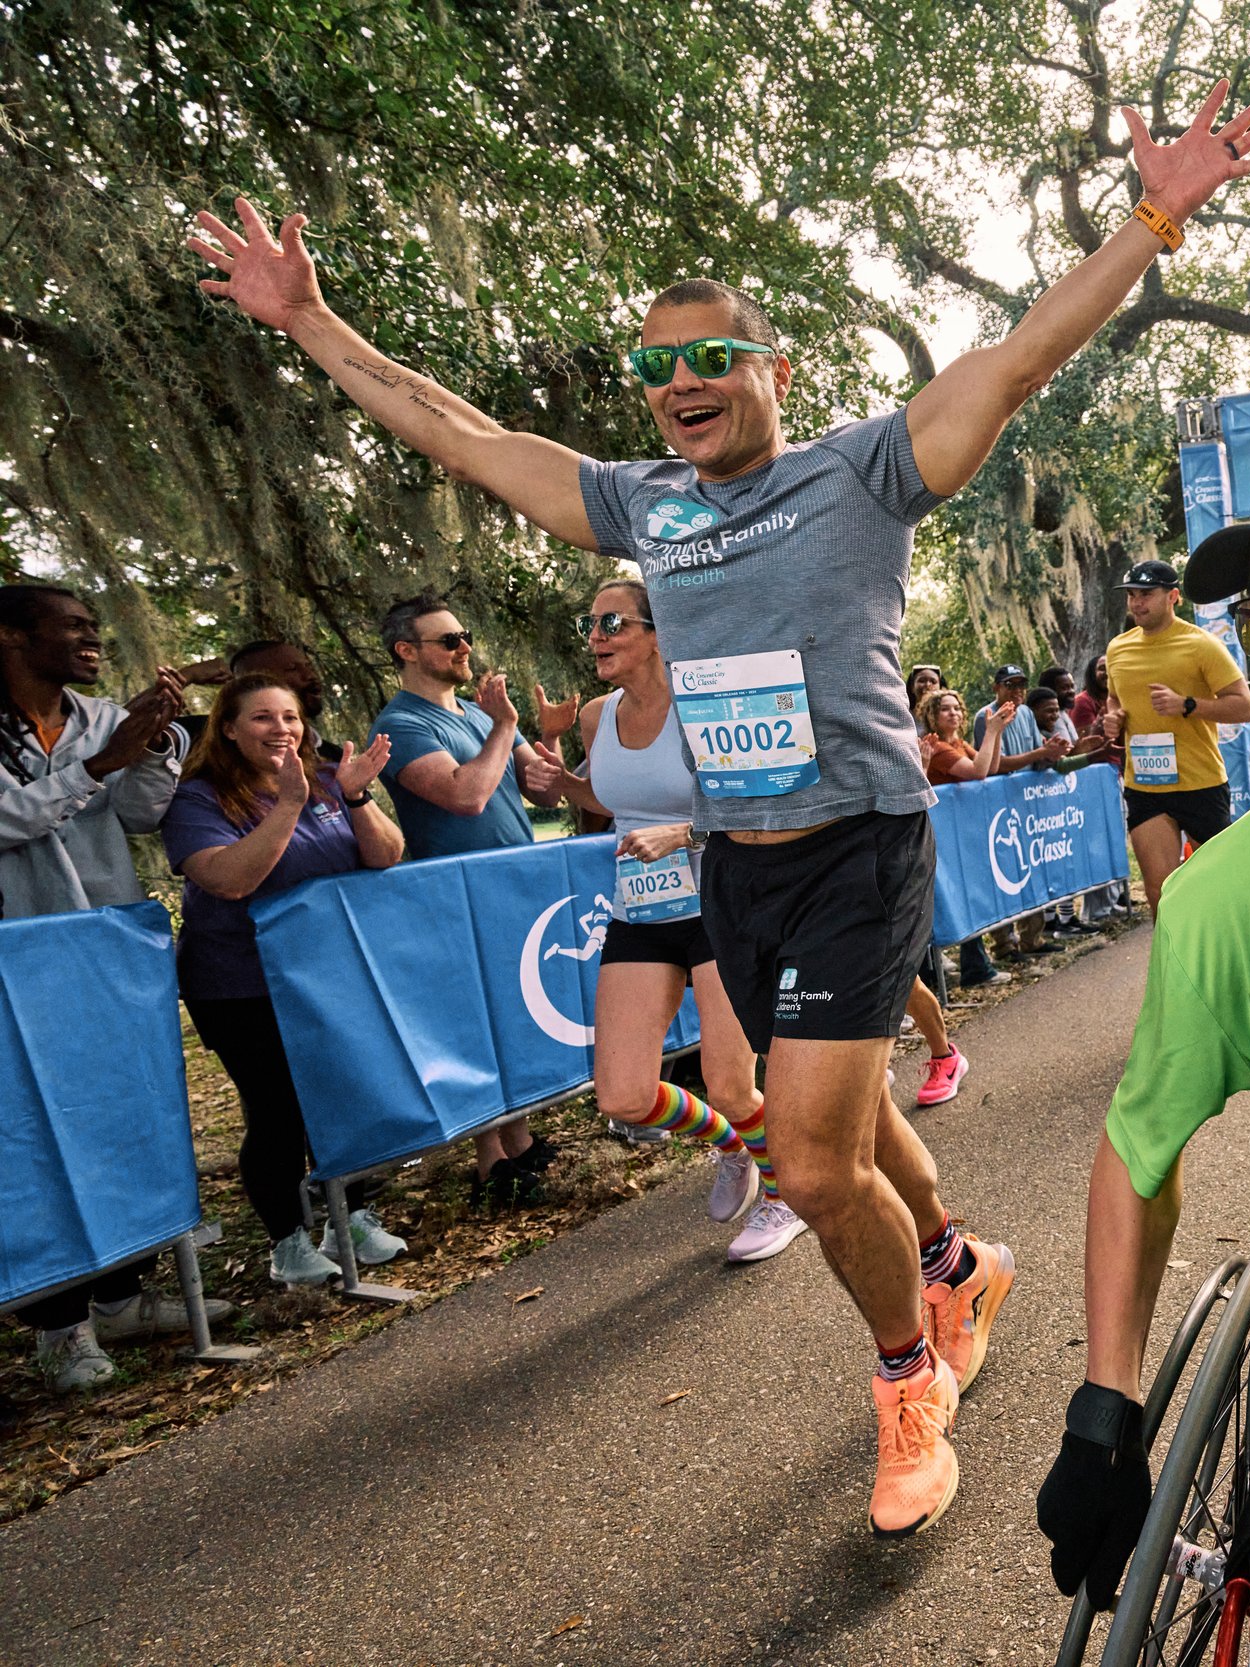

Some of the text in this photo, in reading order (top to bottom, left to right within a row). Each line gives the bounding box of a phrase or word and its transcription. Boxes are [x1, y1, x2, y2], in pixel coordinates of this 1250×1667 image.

[719, 512, 799, 549] Family
[644, 551, 723, 576] Childrens
[669, 568, 725, 589] Health
[697, 678, 718, 686] Classic
[700, 719, 796, 755] 10002
[1137, 757, 1170, 768] 10000
[1023, 782, 1067, 800] LCMC Health
[1026, 805, 1084, 836] Crescent City
[1029, 832, 1073, 867] Classic
[628, 871, 682, 896] 10023
[800, 990, 834, 1002] Family
